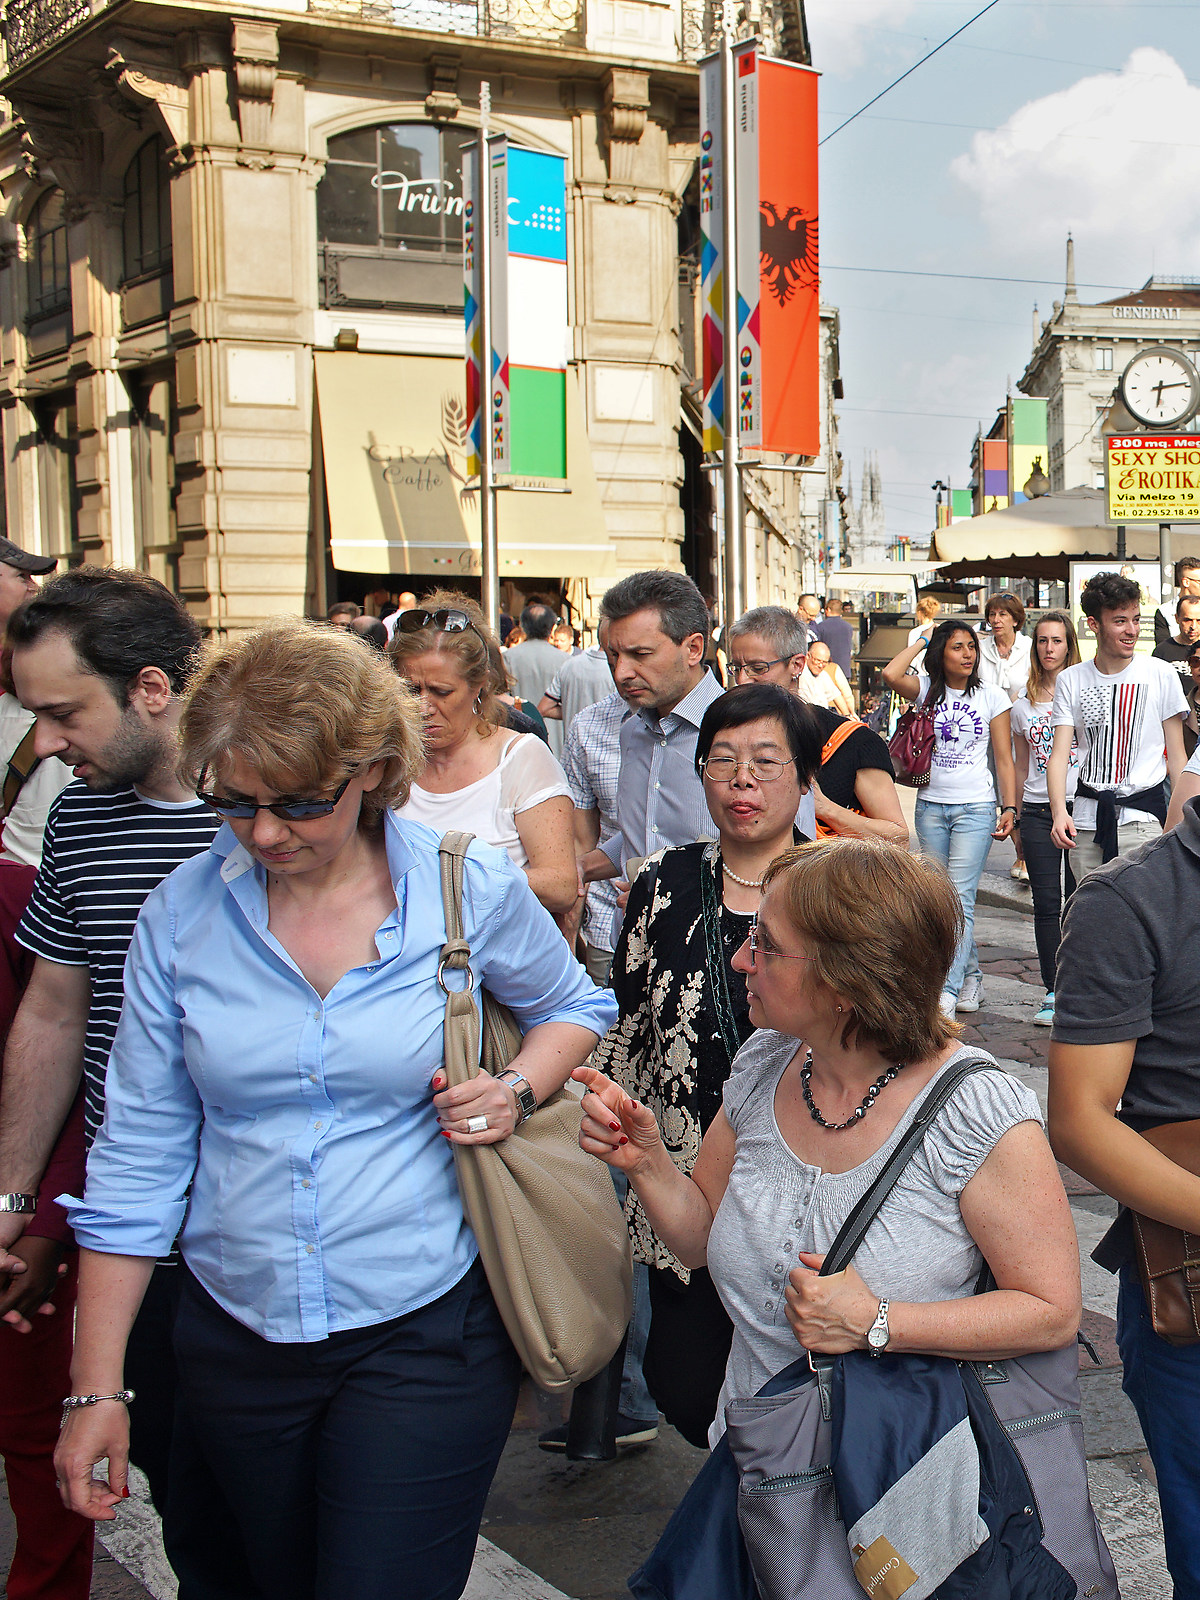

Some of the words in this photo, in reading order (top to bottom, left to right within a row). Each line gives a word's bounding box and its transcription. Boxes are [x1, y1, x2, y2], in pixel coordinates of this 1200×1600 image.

[701, 130, 713, 214] EXPO
[465, 200, 475, 271] EXPO
[1112, 306, 1181, 320] GENERALI
[740, 345, 753, 432] EXPO
[493, 390, 504, 460] EXPO
[1111, 439, 1142, 448] 300
[1144, 440, 1172, 448] mq.
[1111, 452, 1158, 466] SEXY
[1117, 493, 1136, 501] Via
[1140, 493, 1176, 501] Melzo
[1180, 493, 1194, 501] 19
[952, 701, 983, 735] BRAND
[867, 1557, 900, 1595] Conbipel
